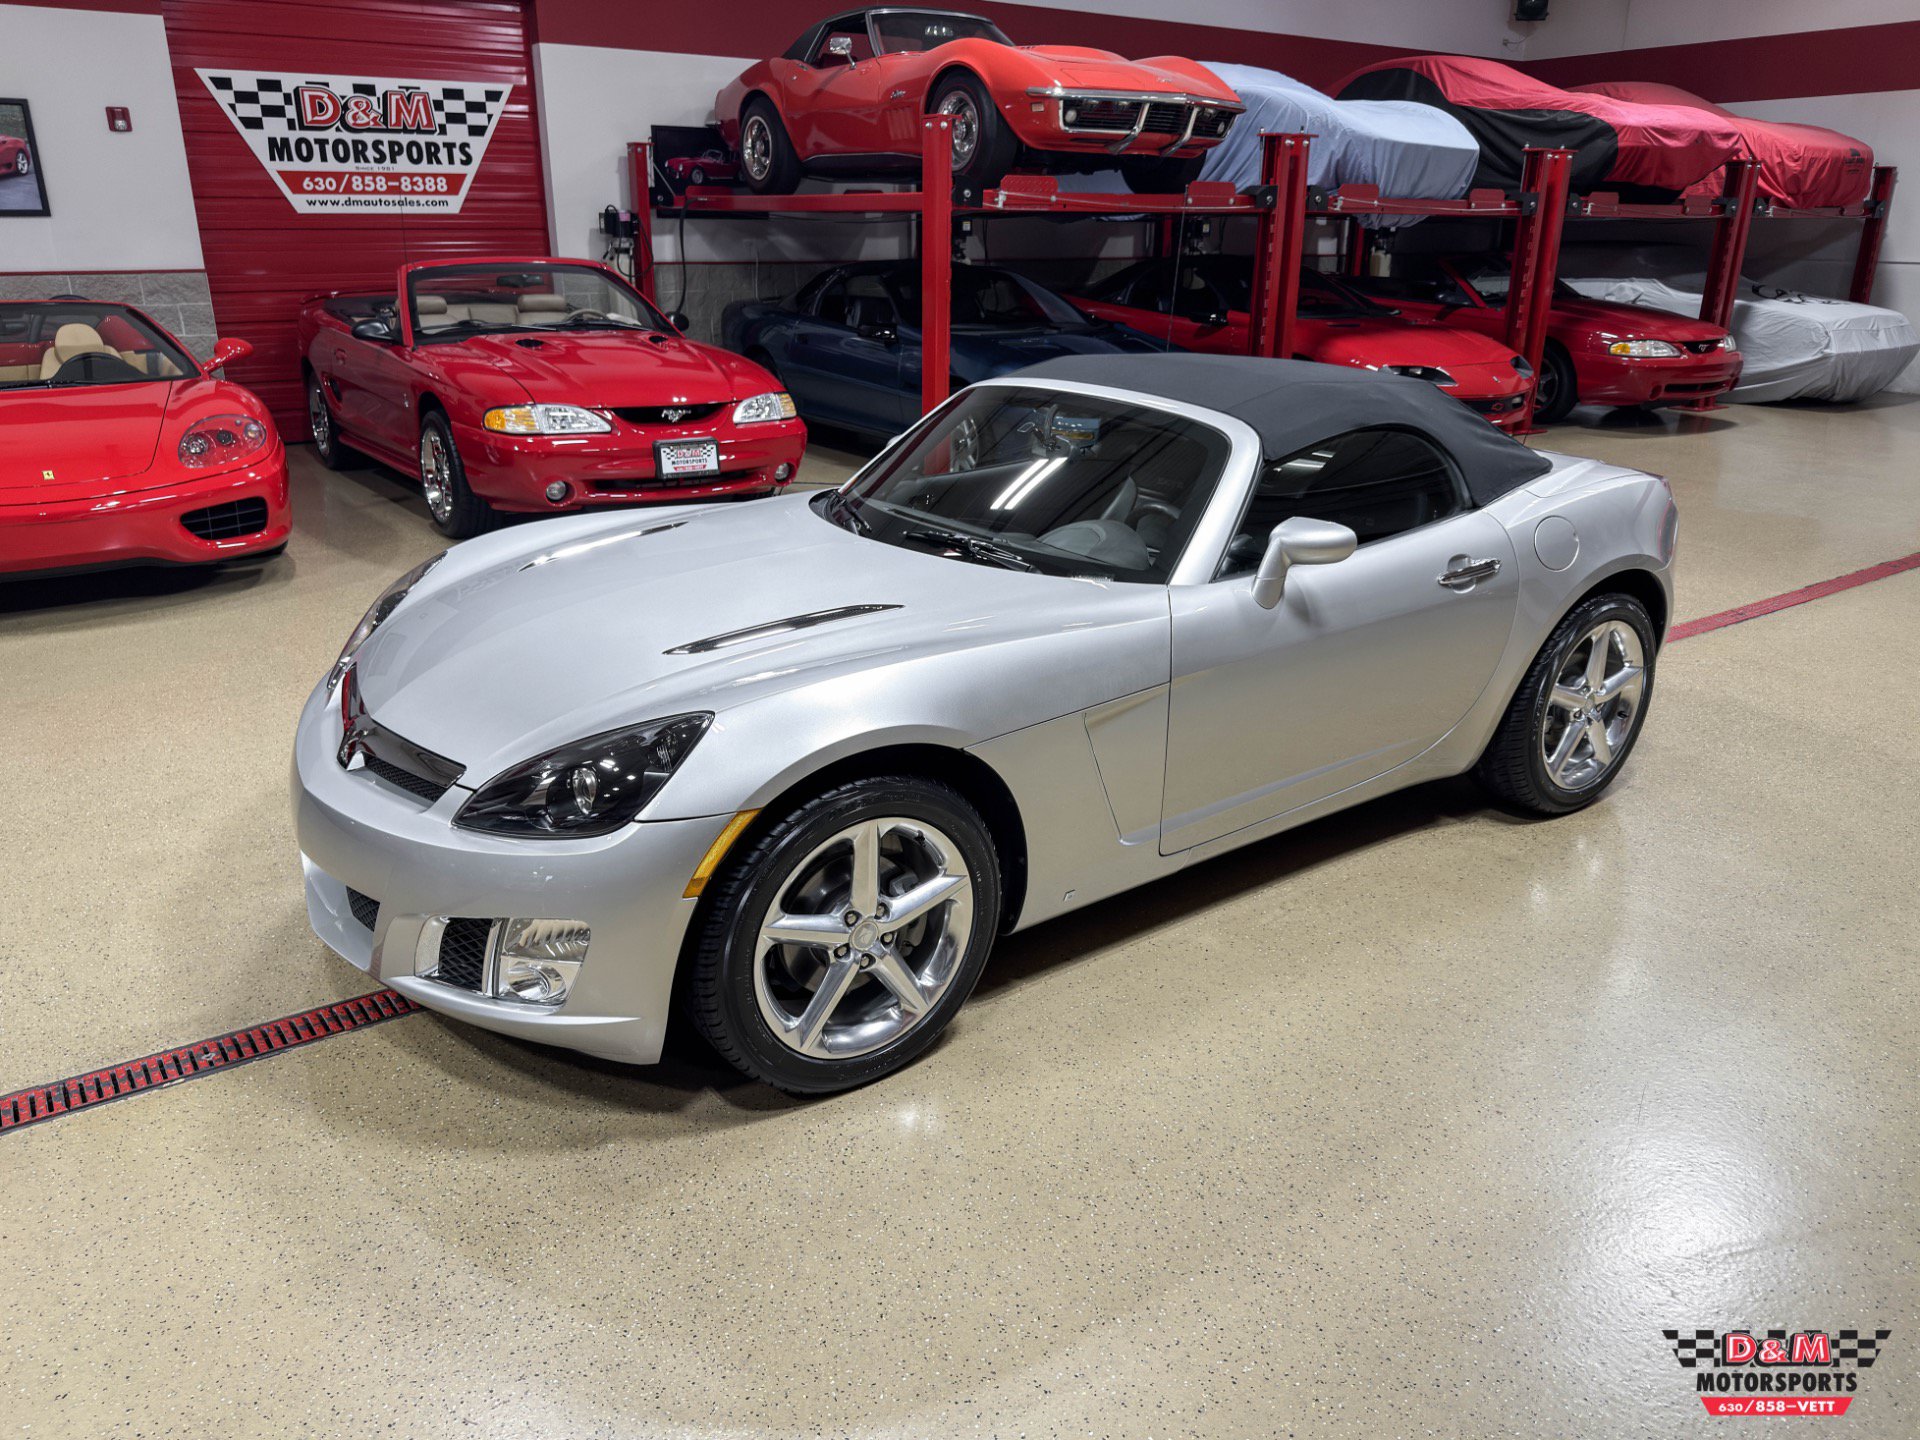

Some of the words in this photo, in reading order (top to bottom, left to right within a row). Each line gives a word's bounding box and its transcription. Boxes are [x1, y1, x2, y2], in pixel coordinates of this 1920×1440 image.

[297, 86, 438, 133] D&M
[267, 136, 473, 166] MOTORSPORTS
[305, 196, 449, 208] www.dmautosales.com
